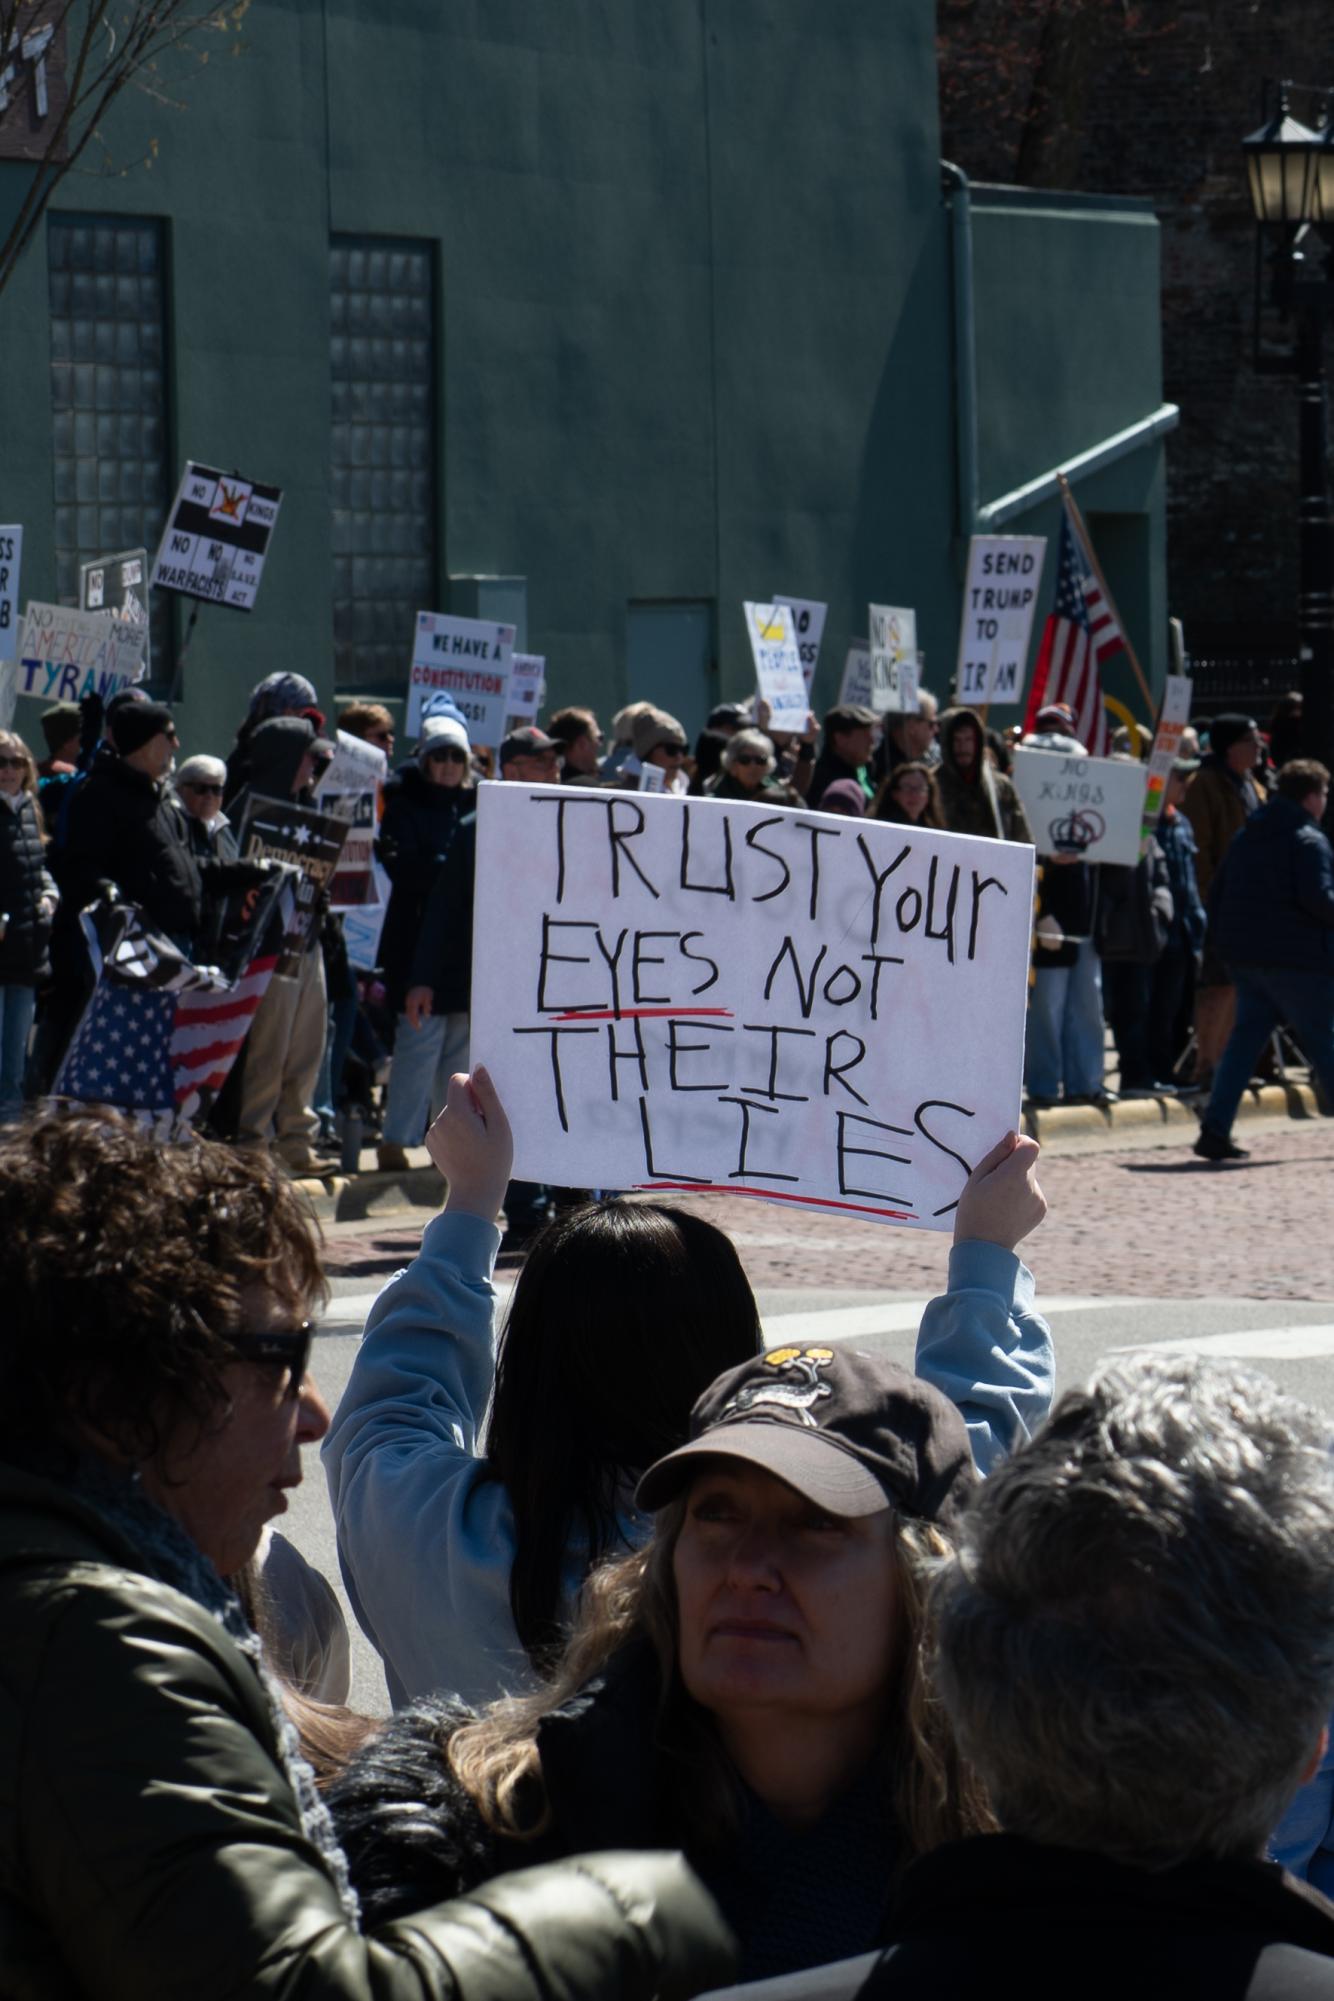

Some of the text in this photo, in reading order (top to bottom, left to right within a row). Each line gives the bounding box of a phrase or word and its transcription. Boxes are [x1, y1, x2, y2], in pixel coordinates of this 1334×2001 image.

[191, 484, 207, 500] NO
[170, 535, 190, 555] NO
[207, 543, 223, 562] NO
[158, 564, 187, 586] WAR
[982, 553, 1034, 576] SEND
[971, 588, 1034, 610] TRUMP
[28, 607, 54, 629] NO
[109, 622, 145, 648] MORE
[976, 618, 998, 641] TO
[24, 627, 117, 674] AMERICAN
[432, 634, 502, 662] WE HAVE A
[412, 665, 503, 695] CONSTITUTION
[1060, 758, 1089, 777] NO
[530, 795, 841, 921] TRUST
[536, 912, 719, 1020] EYES
[512, 1015, 869, 1134] THEIR
[639, 1095, 976, 1217] LIES
